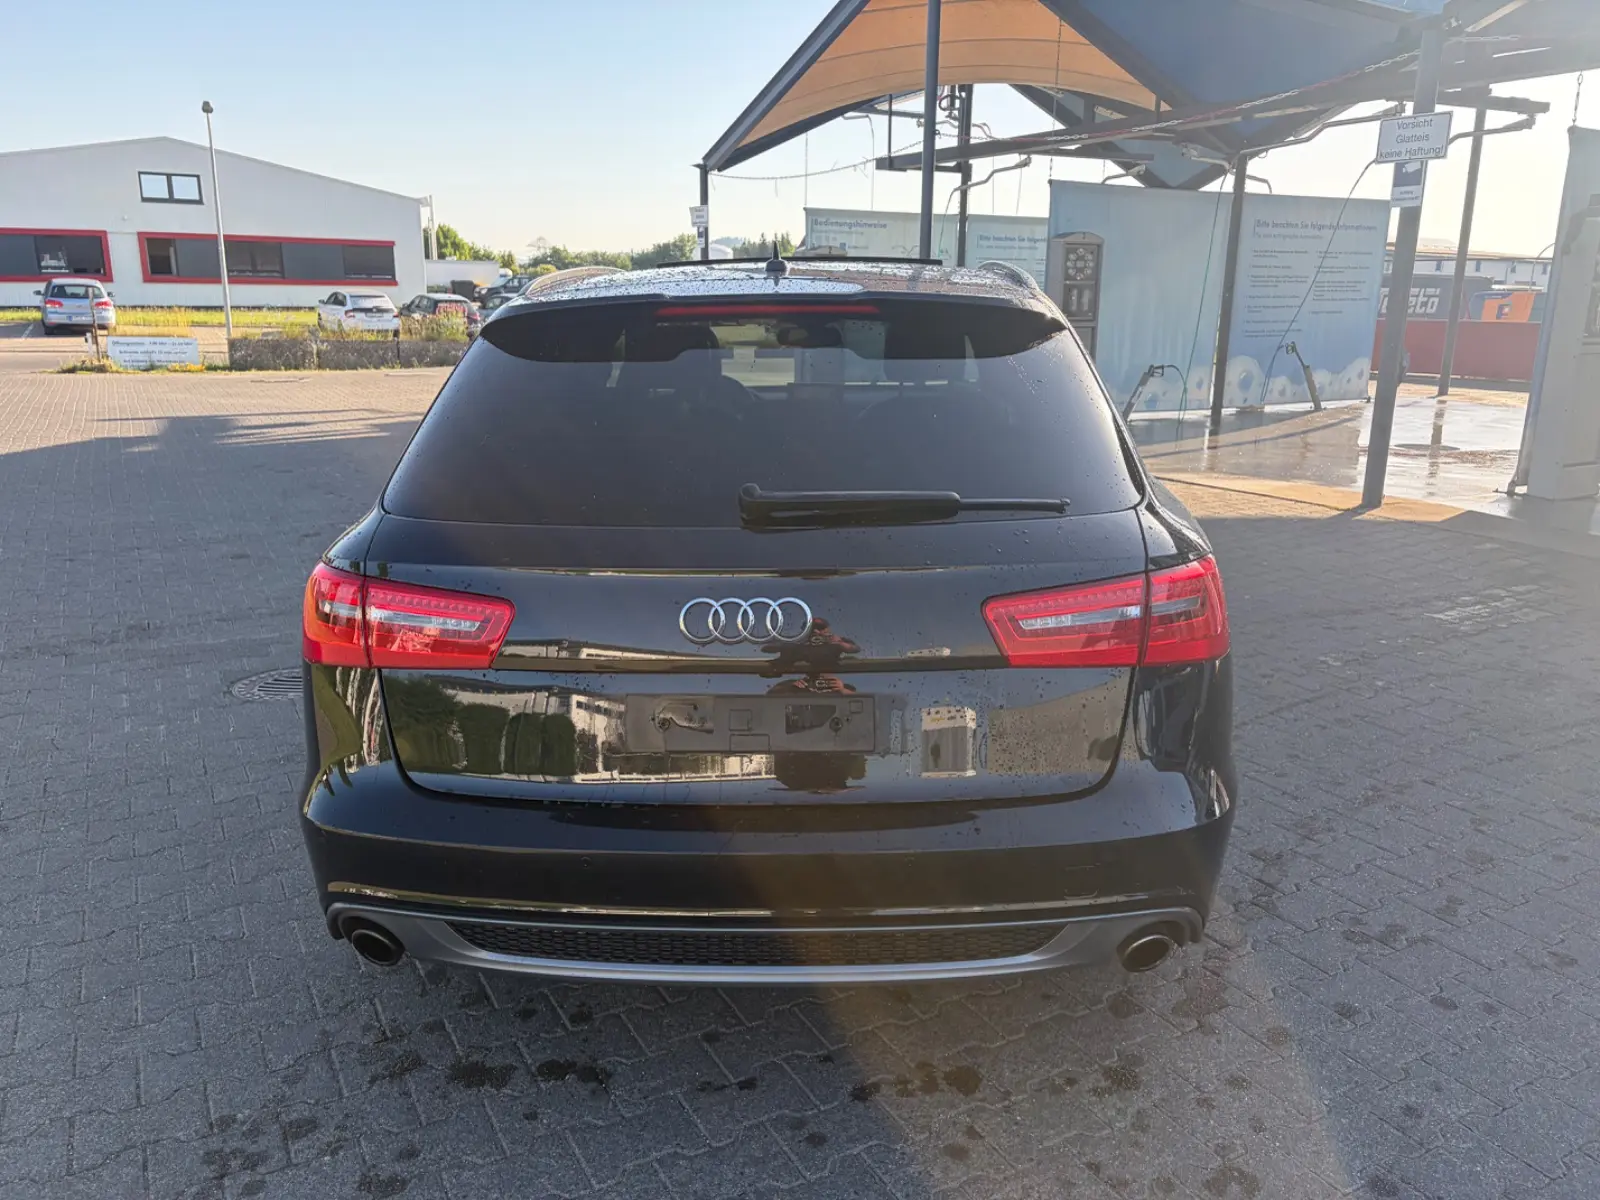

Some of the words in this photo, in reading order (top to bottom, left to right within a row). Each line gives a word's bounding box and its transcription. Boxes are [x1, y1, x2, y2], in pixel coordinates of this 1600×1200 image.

[1397, 119, 1433, 130] Vorsicht
[1396, 132, 1430, 143] Glatteis
[1380, 148, 1402, 159] keine
[1405, 144, 1444, 158] Haftung!
